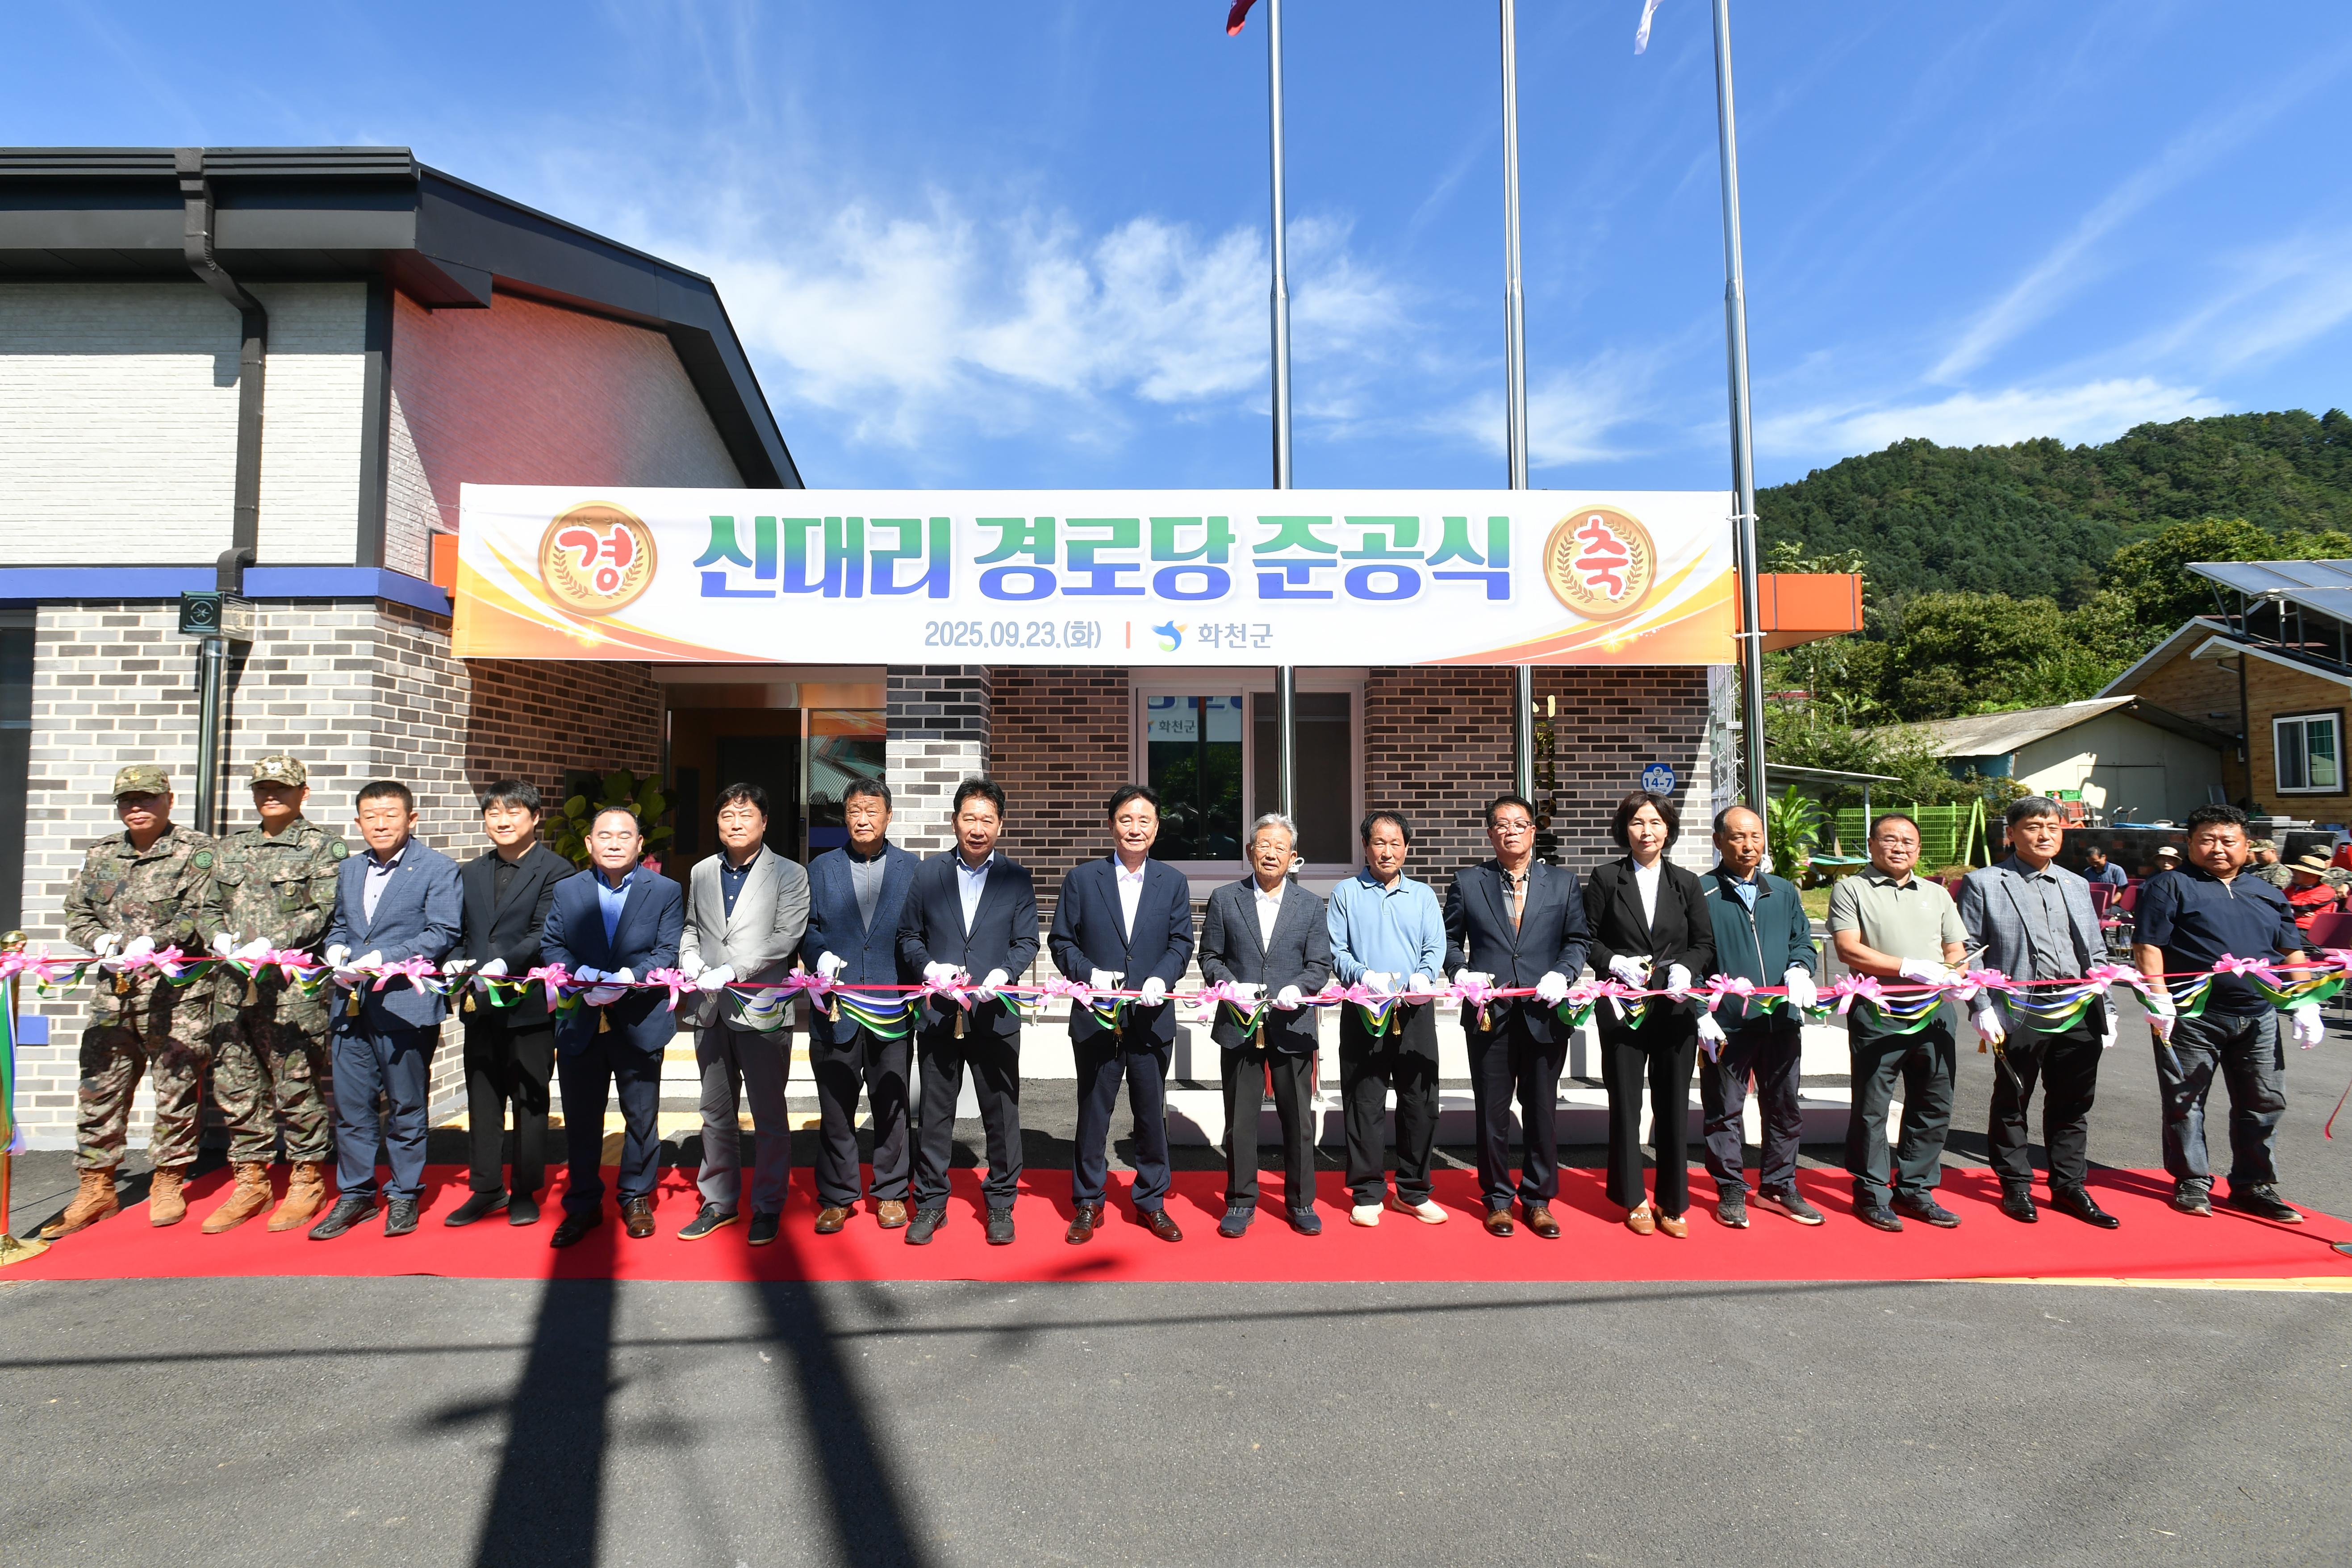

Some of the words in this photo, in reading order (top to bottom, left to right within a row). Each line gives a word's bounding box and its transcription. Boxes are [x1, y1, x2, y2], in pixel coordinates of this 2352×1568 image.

[560, 527, 633, 591] 경
[693, 516, 951, 599] 신대리
[974, 516, 1236, 601] 경로당
[1253, 516, 1510, 601] 준공식
[1575, 518, 1628, 596] 축
[925, 621, 1101, 648] 2025.09.23.(화)
[1198, 623, 1273, 649] 화천군
[1644, 778, 1673, 787] 14-7
